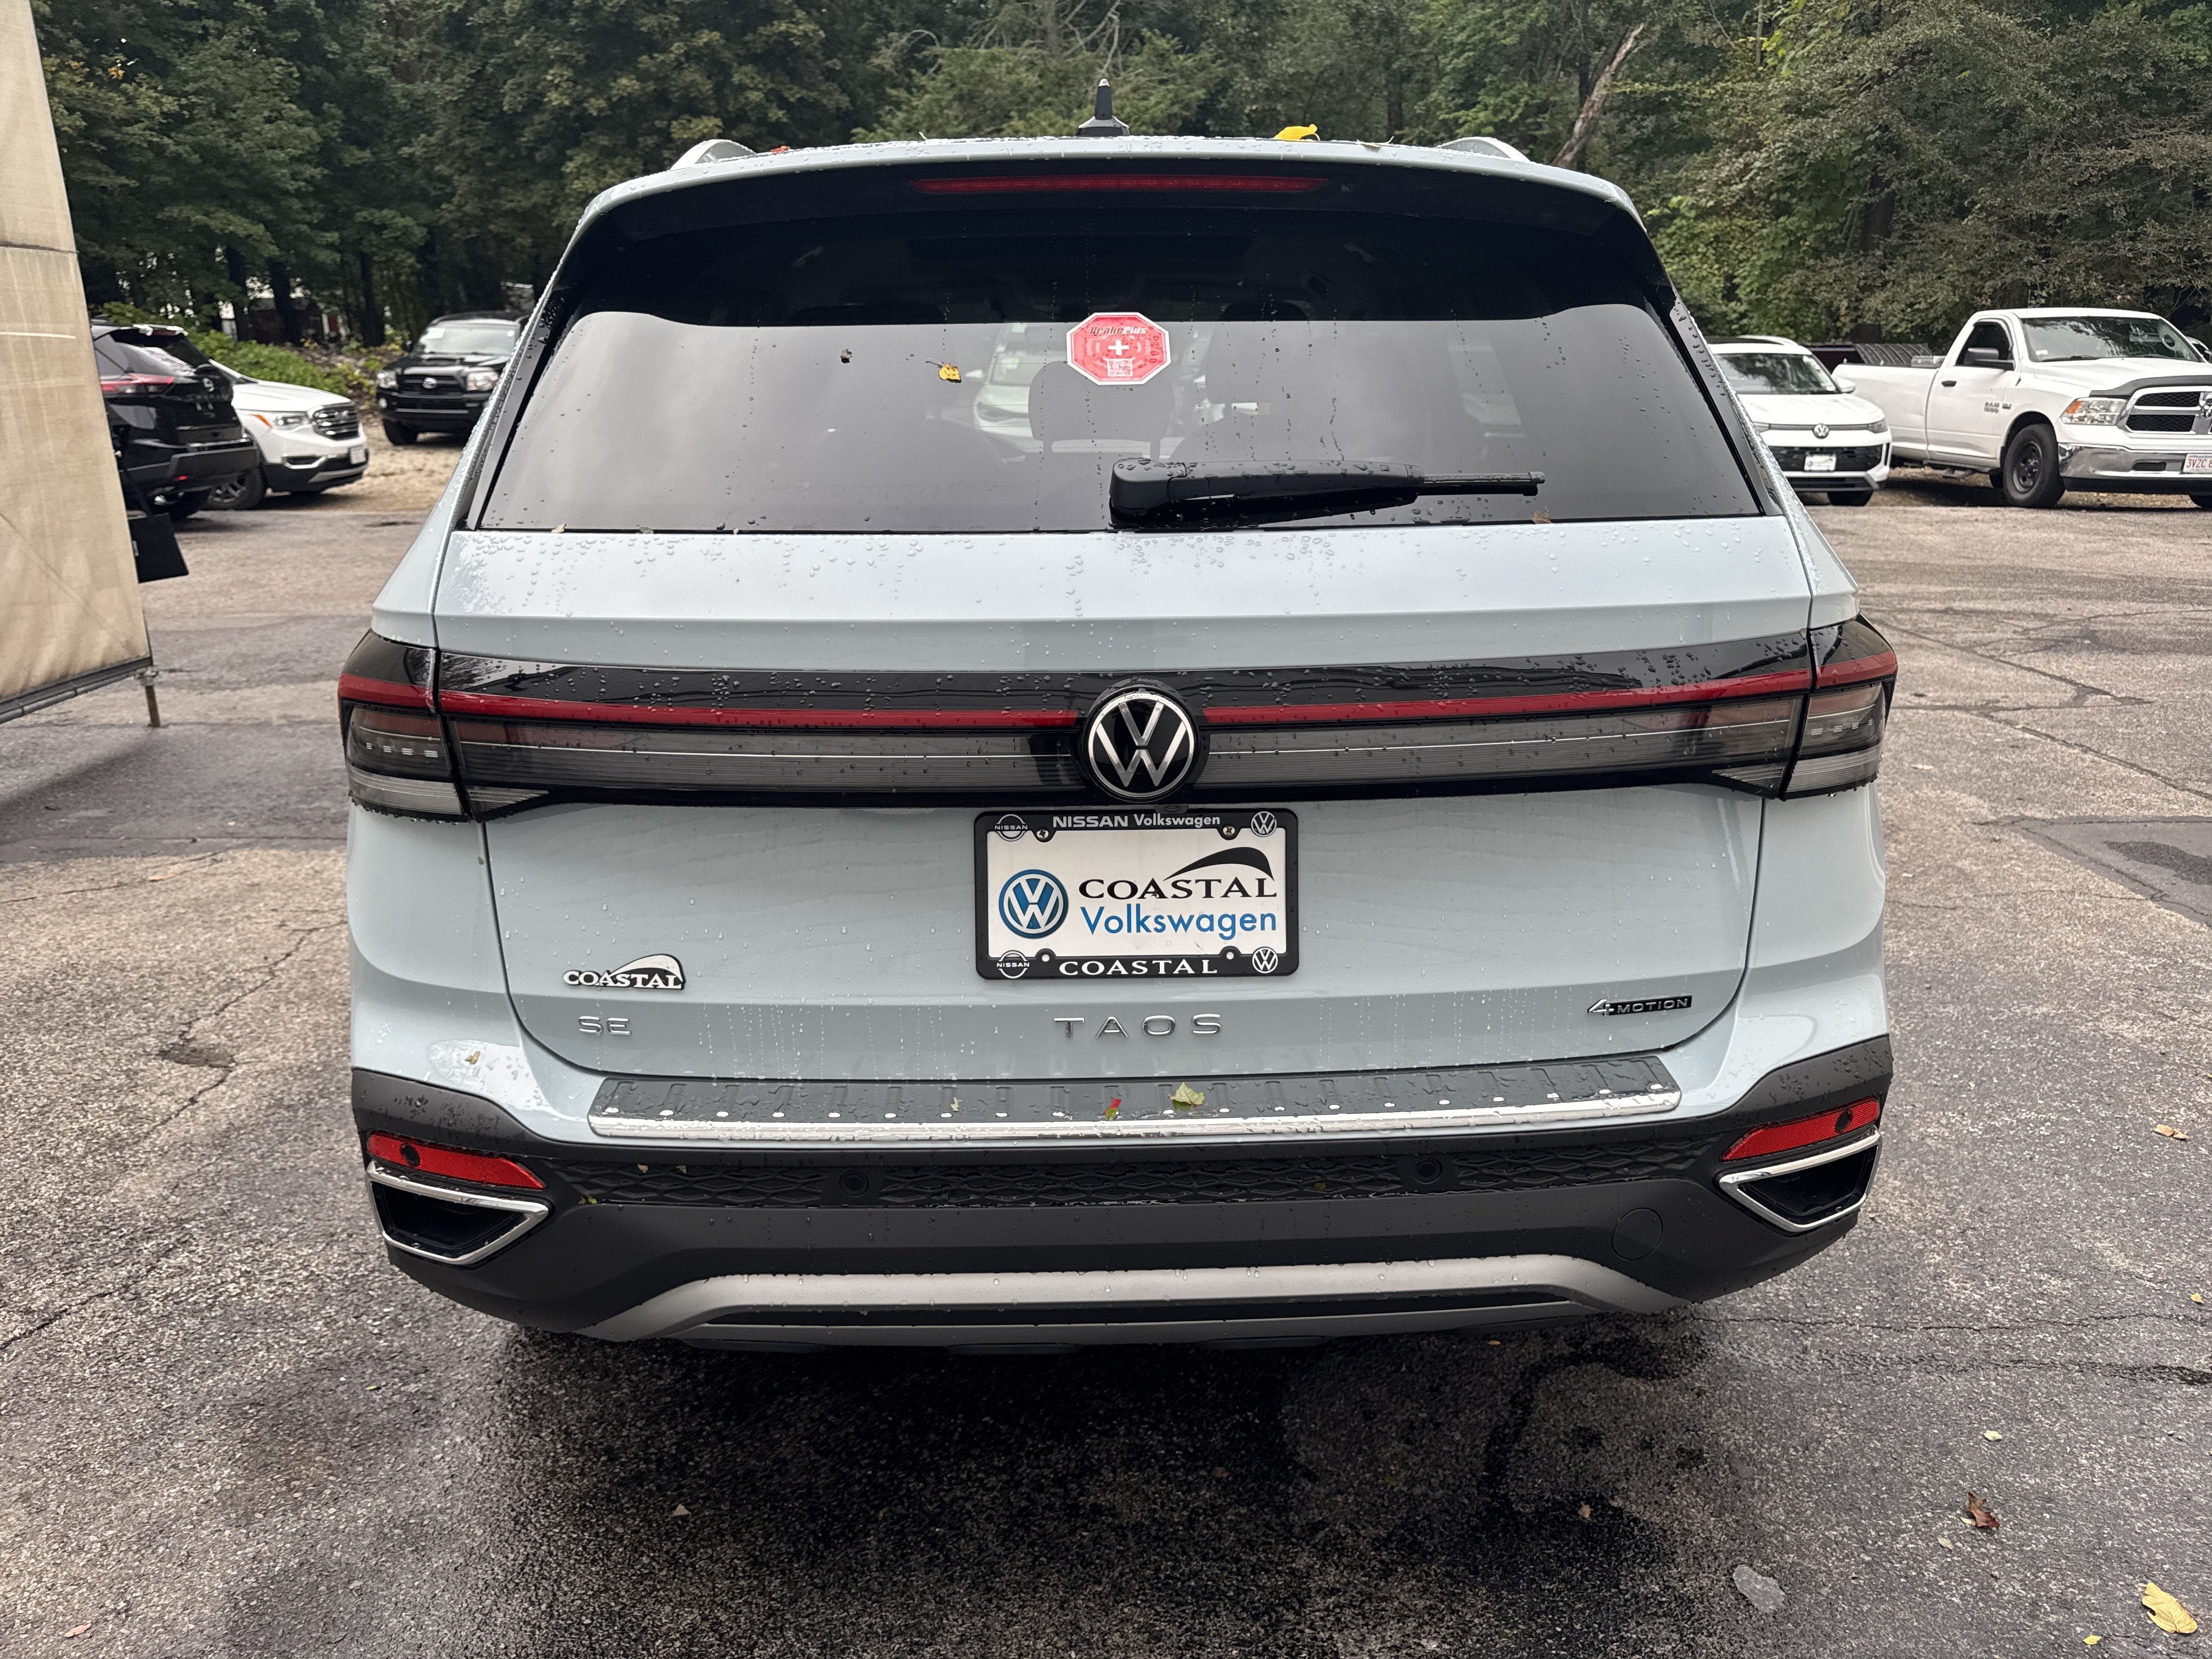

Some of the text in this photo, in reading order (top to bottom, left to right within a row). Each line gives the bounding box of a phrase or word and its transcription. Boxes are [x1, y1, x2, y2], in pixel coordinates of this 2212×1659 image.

[1092, 698, 1190, 792] VW
[1053, 814, 1220, 827] NISSAN Volkswagen
[1251, 811, 1276, 836] VW
[1079, 877, 1277, 899] COASTAL
[1002, 872, 1065, 935] VW
[1080, 904, 1276, 940] Volkswagen
[1059, 959, 1217, 975] COASTAL
[1252, 947, 1277, 973] VW
[563, 971, 682, 989] COASTAL
[578, 1015, 631, 1035] SE
[1053, 1014, 1221, 1038] TAOS
